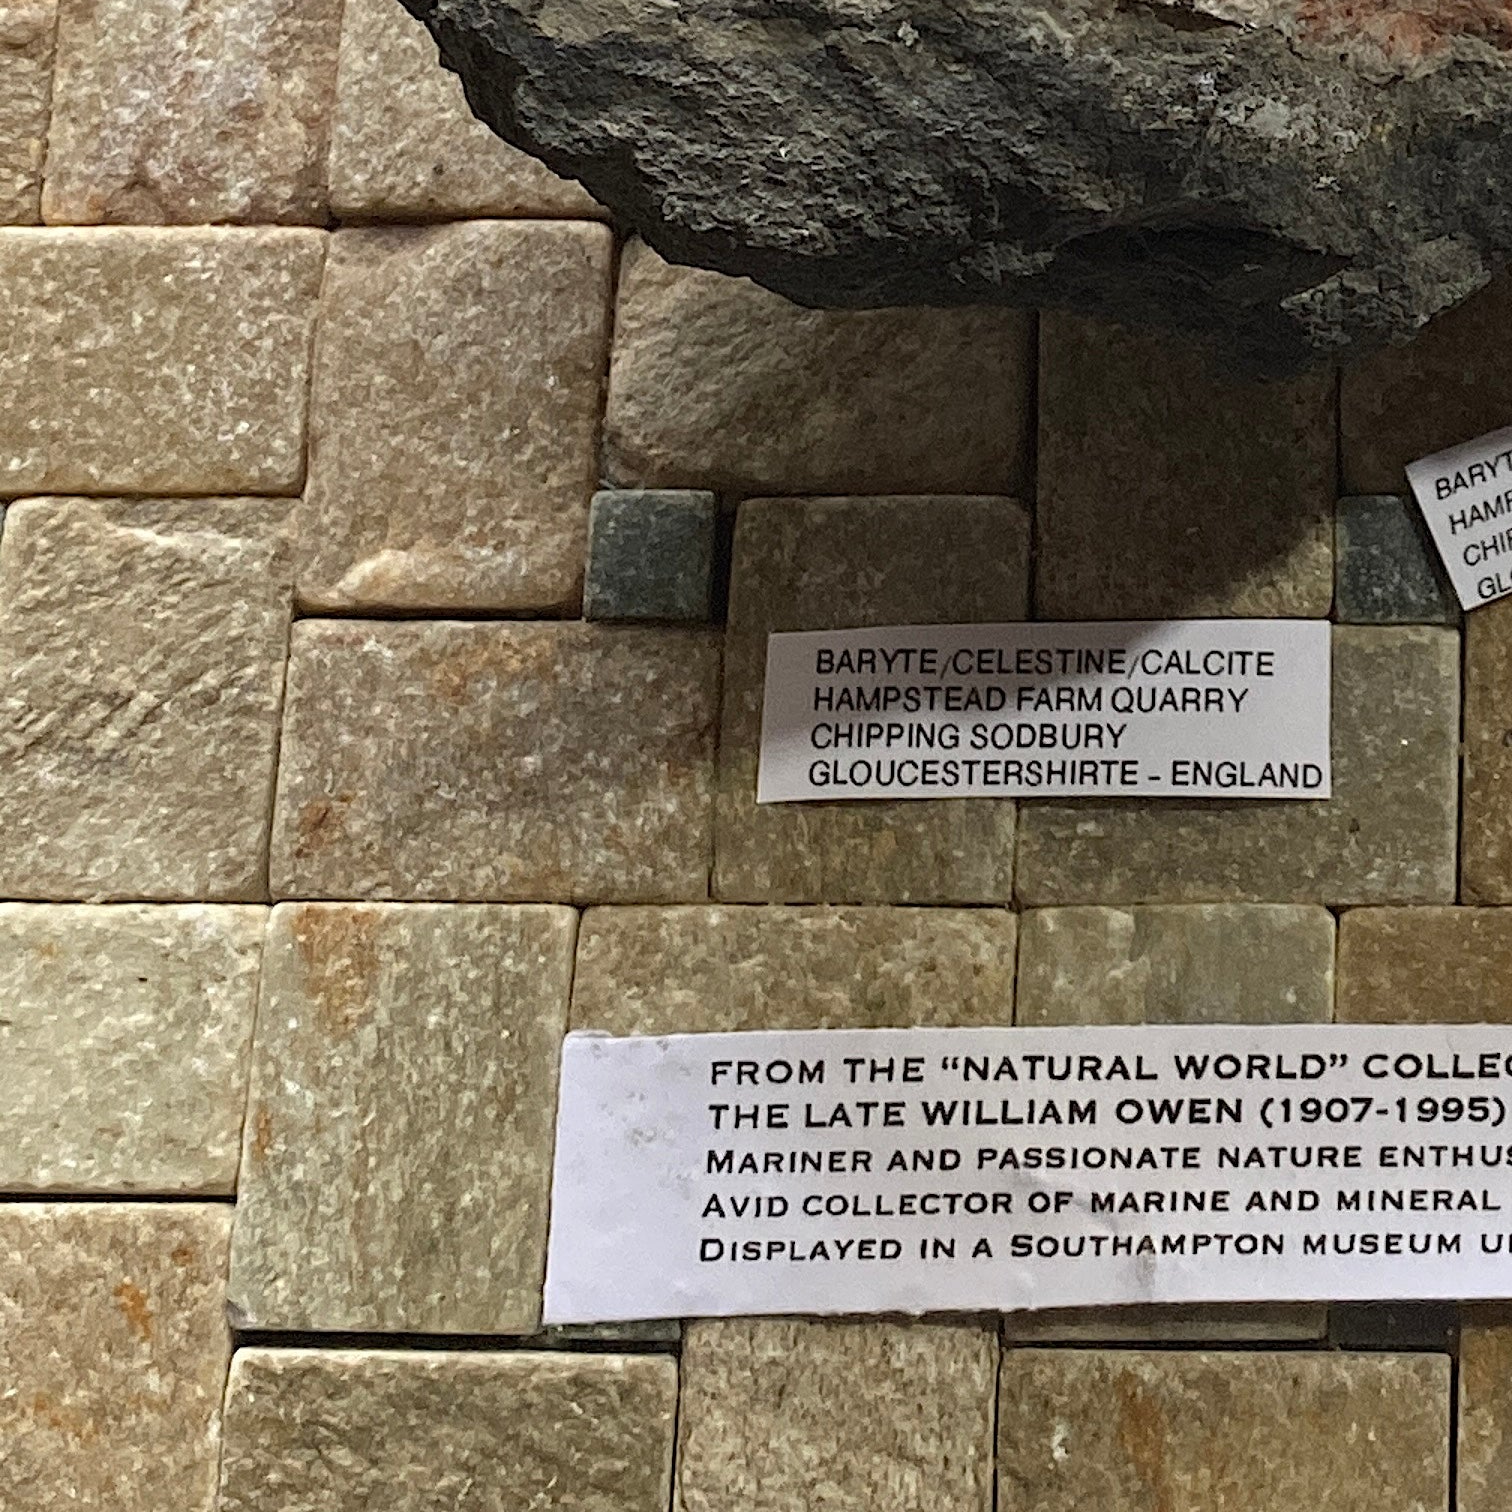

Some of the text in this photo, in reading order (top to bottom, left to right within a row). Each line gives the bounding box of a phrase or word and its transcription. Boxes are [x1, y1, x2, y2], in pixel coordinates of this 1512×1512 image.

[815, 649, 1275, 680] BARYTE/CELESTINE/CALCITE
[814, 687, 1249, 713] HAMPSTEAD FARM QUARRY
[811, 723, 1128, 750] CHIPPING SODBURY
[809, 760, 1139, 787] GLOUCESTERSHIRTE
[1171, 762, 1323, 788] ENGLAND
[711, 1061, 825, 1086] FROM
[843, 1057, 925, 1083] THE
[708, 1095, 1507, 1129] THE LATE WILLIAM OWEN (1907-1995)
[706, 1150, 872, 1174] MARINER
[887, 1149, 960, 1172] AND
[977, 1146, 1200, 1171] PASSIONATE
[1218, 1145, 1362, 1169] NATURE
[702, 1194, 789, 1219] AVID
[802, 1193, 1012, 1217] COLLECTOR
[1027, 1192, 1073, 1214] OF
[1091, 1191, 1230, 1213] MARINE
[1245, 1190, 1320, 1213] AND
[1336, 1189, 1501, 1212] MINERAL
[700, 1238, 902, 1263] DISPLAYED
[920, 1237, 957, 1260] IN
[971, 1236, 994, 1259] A
[1011, 1234, 1284, 1259] SOUTHAMPTON
[1303, 1232, 1462, 1255] MUSEUM
